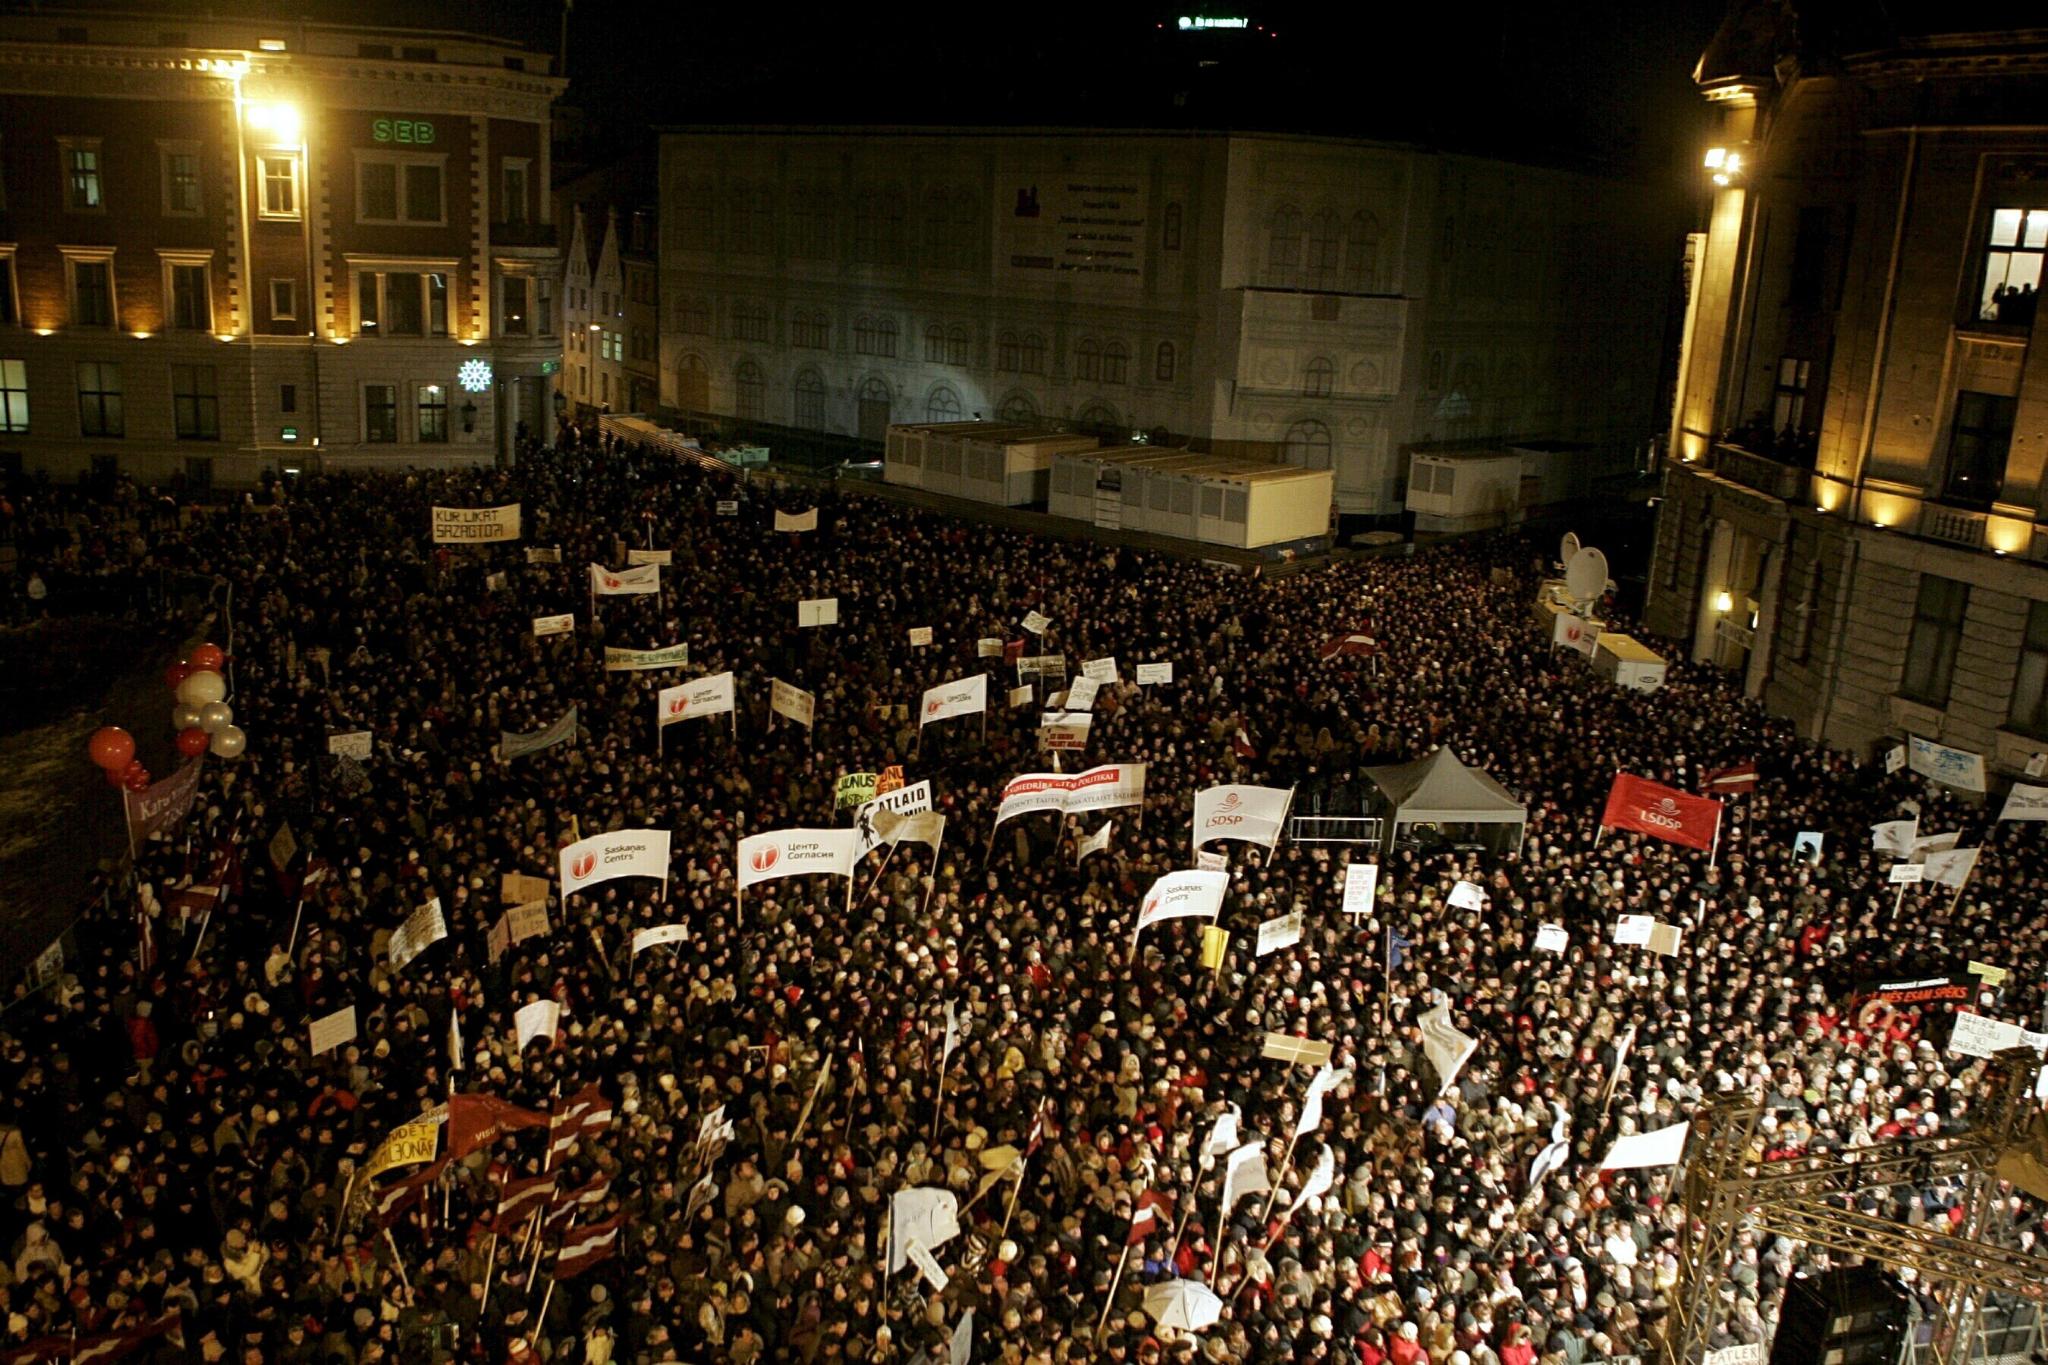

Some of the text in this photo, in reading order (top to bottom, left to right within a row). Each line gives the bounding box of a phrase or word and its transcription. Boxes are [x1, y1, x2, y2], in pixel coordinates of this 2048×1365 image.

[373, 120, 436, 143] SEB
[436, 510, 460, 521] KUR
[1078, 773, 1114, 786] POLITIKAI
[1205, 815, 1243, 828] LSDSP
[1640, 810, 1682, 830] LSDSP
[788, 843, 819, 852] Центр
[604, 854, 634, 864] Centrs
[787, 851, 835, 860] Согласия
[475, 1127, 497, 1142] VISU
